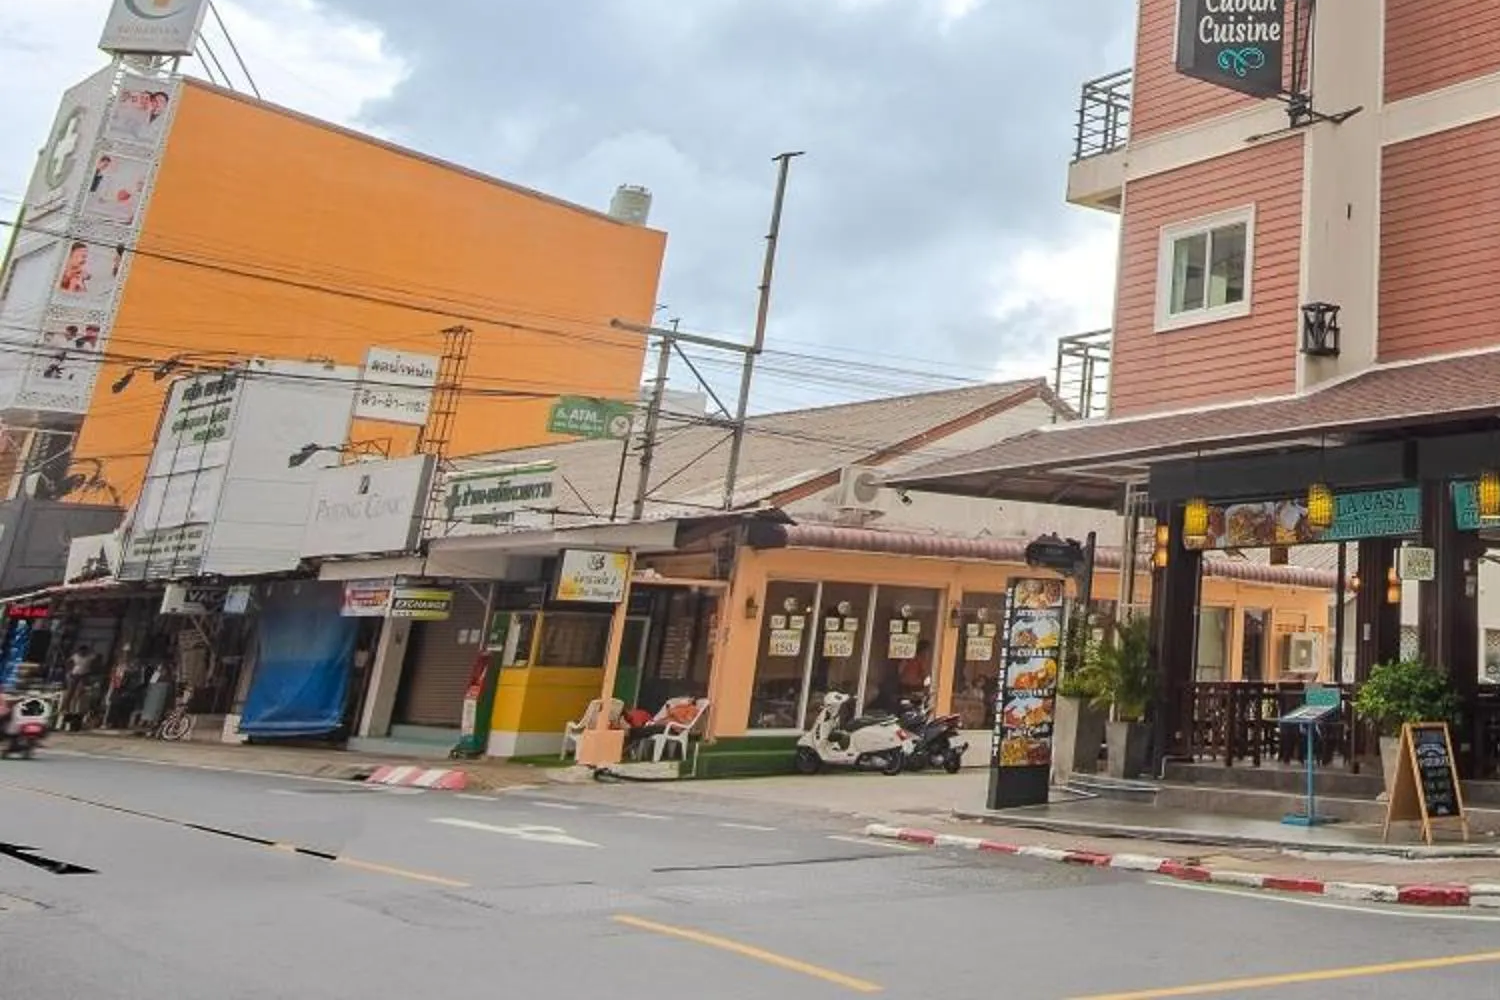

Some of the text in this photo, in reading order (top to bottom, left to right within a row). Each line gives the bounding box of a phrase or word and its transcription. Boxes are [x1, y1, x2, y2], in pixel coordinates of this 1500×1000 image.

[1199, 16, 1281, 44] Cuisine
[1334, 491, 1406, 519] LA CASA
